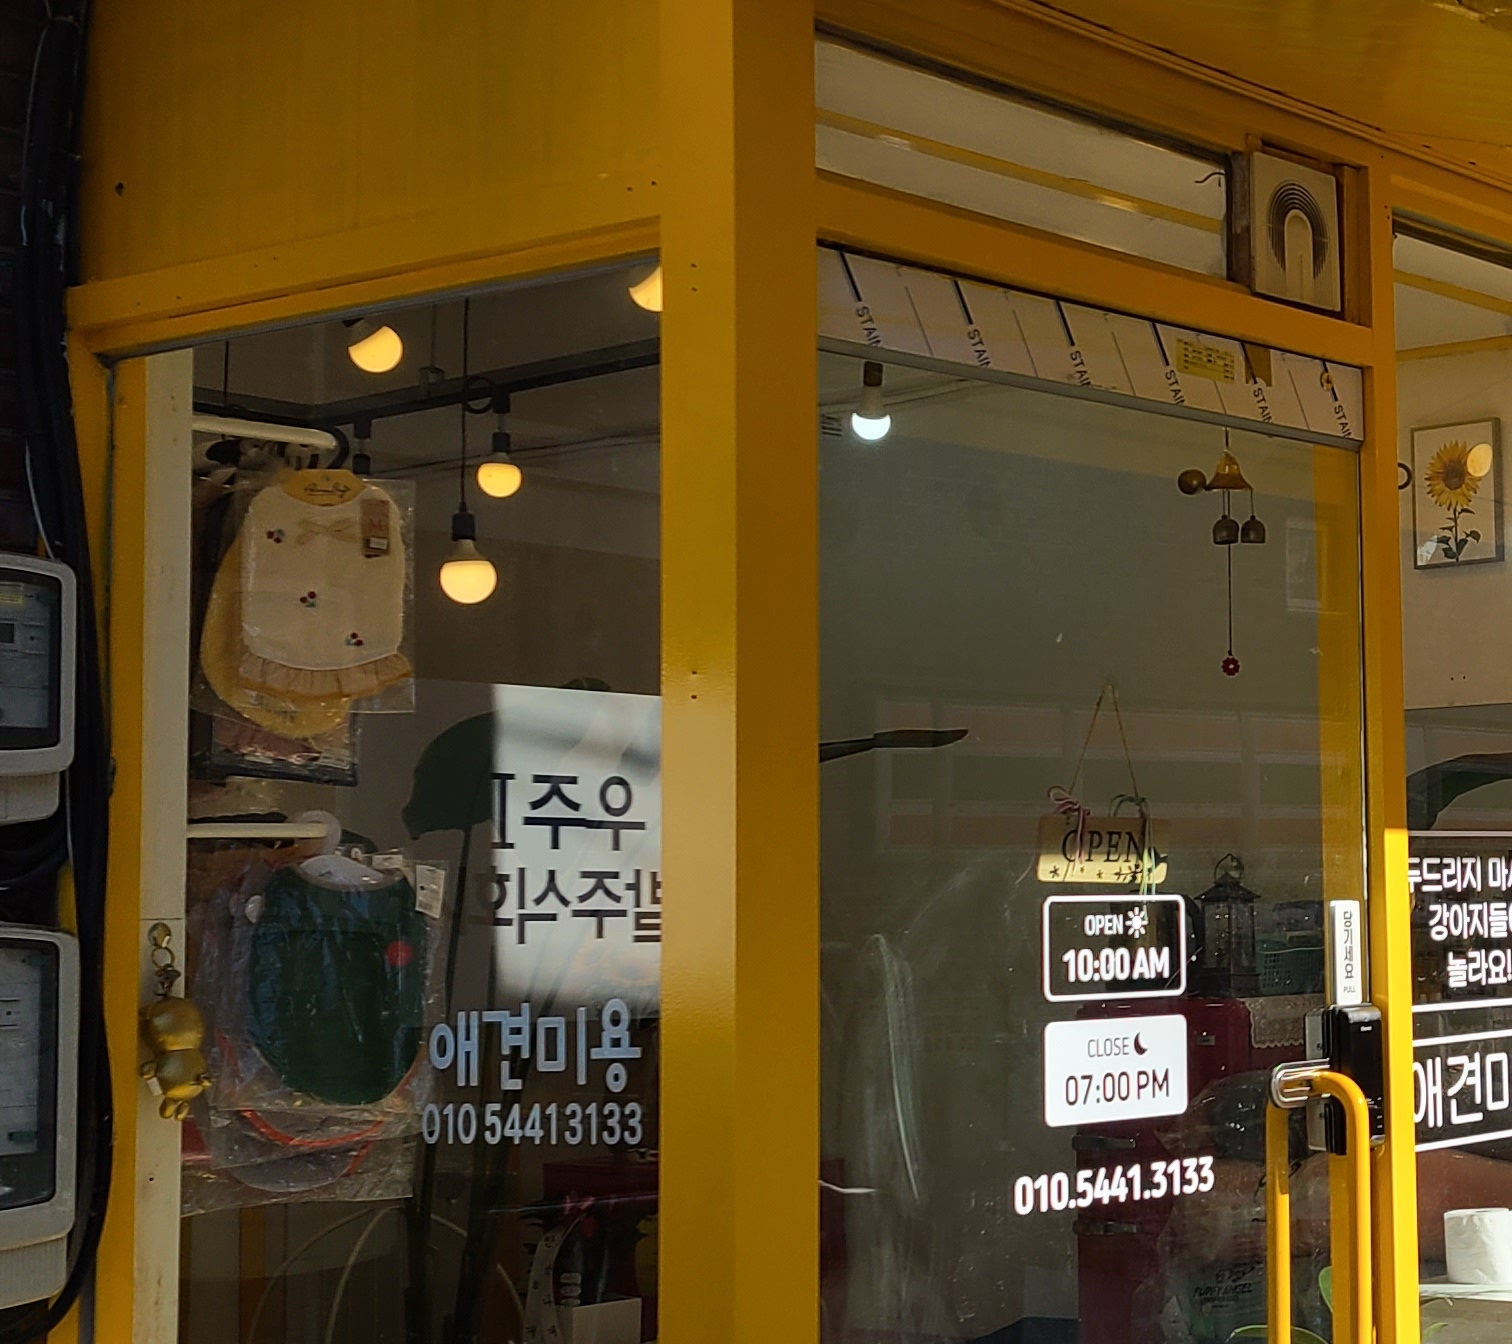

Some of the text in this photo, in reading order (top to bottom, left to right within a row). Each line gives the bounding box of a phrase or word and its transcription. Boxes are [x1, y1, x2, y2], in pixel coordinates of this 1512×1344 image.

[1062, 828, 1145, 863] OPEN
[1084, 914, 1124, 937] OPEN
[1343, 910, 1355, 981] 당기세요
[1062, 946, 1170, 983] 10:00 AM
[1447, 949, 1512, 989] 놀라요!
[1343, 985, 1357, 994] PULL
[429, 998, 641, 1092] 애견미용
[1087, 1036, 1130, 1058] CLOSE
[1065, 1068, 1170, 1106] 07:00 PM
[1013, 1155, 1215, 1216] 010.5441.3133
